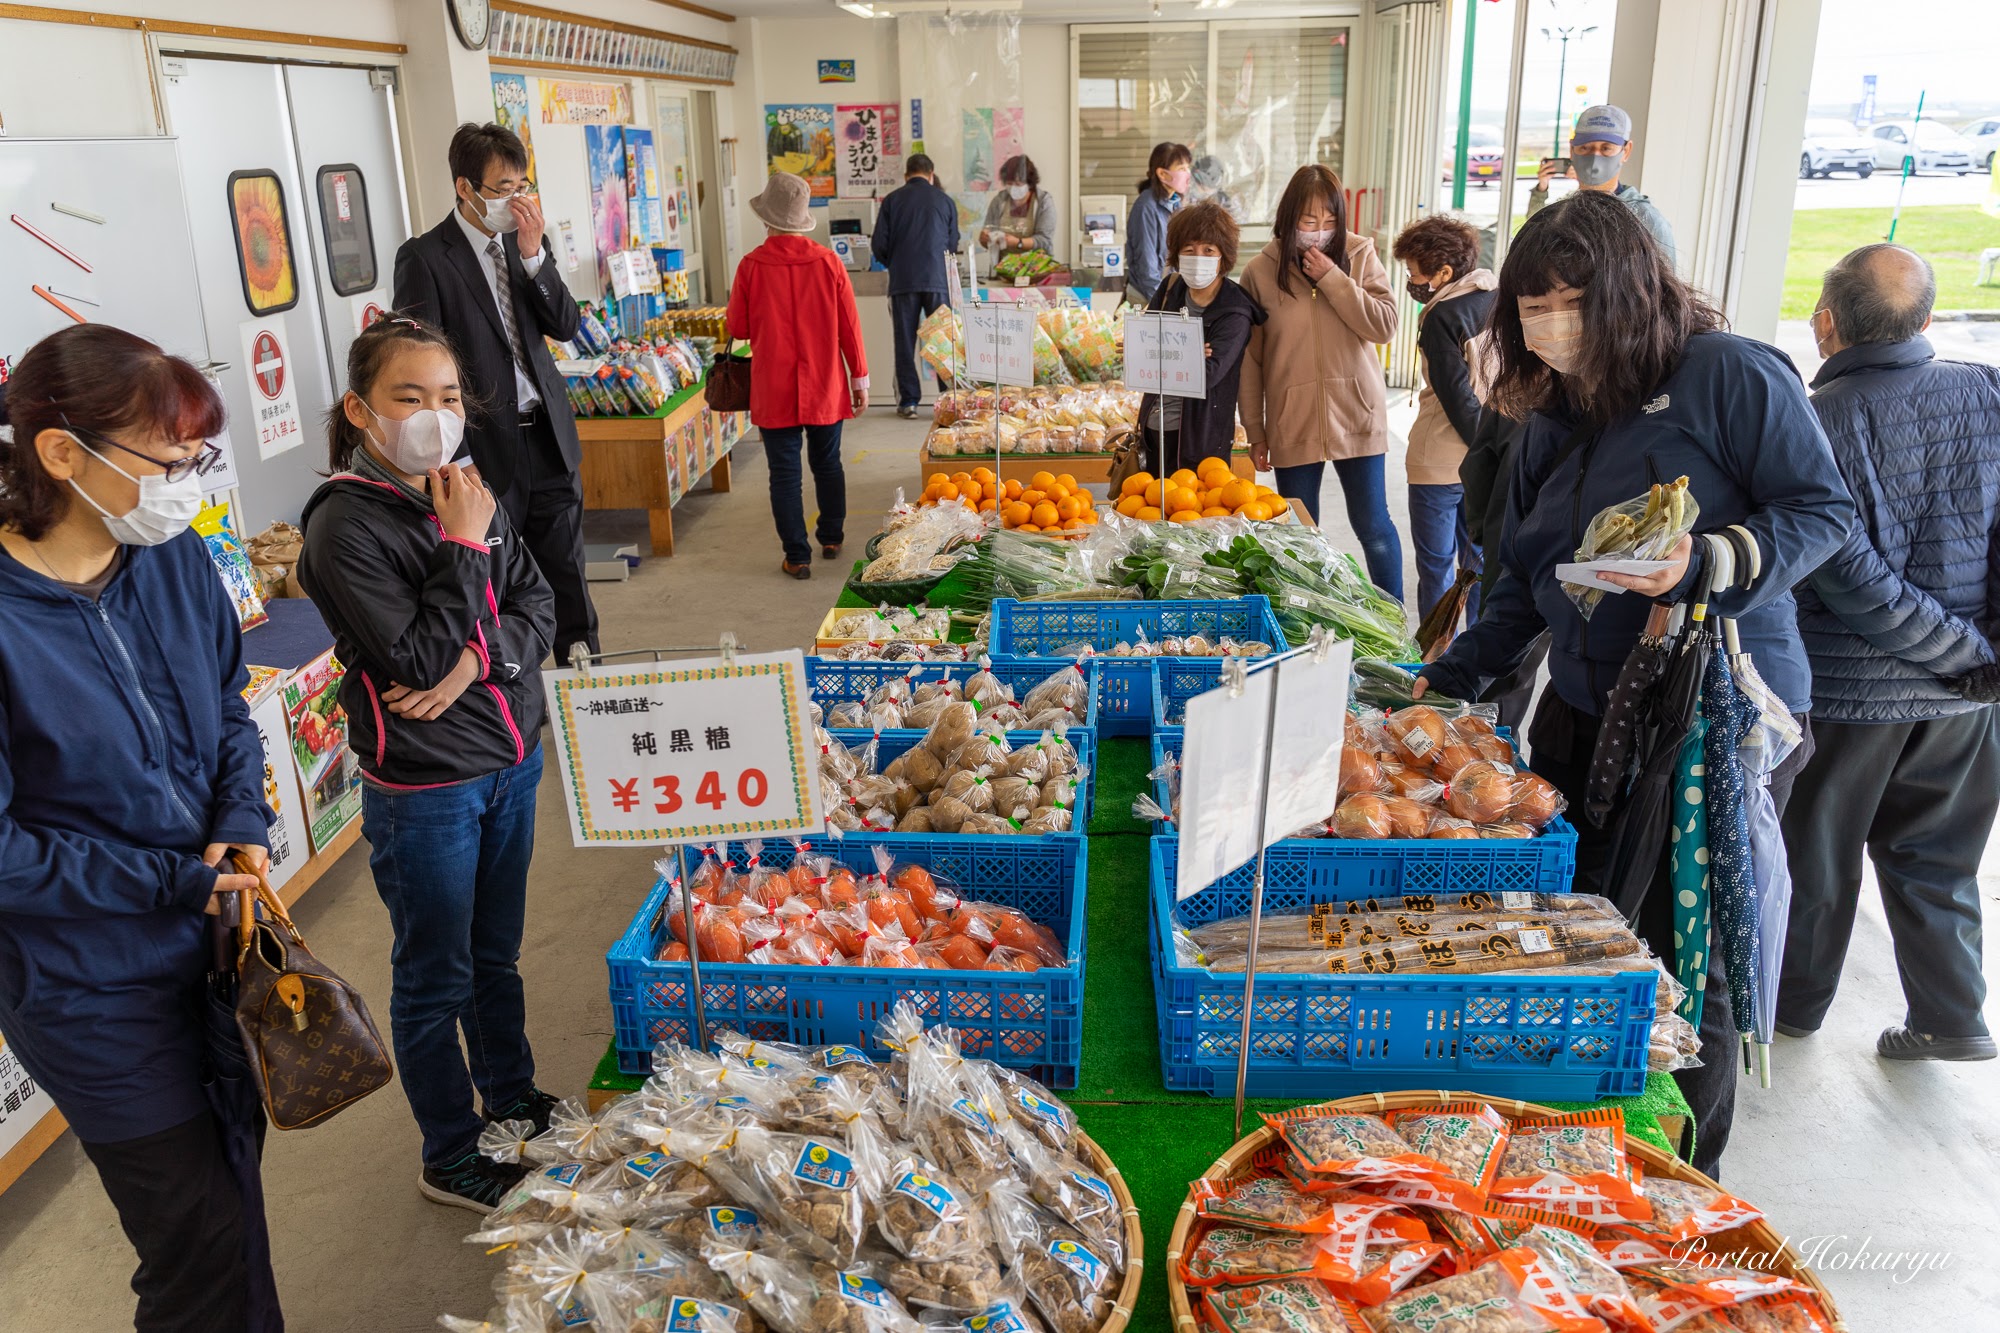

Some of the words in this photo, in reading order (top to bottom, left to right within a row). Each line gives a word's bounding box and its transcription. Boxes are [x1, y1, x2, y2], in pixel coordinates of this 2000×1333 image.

[855, 108, 878, 173] ひまわり
[848, 145, 863, 179] ライス
[261, 402, 291, 421] 関係者以外
[262, 418, 297, 444] 立入禁止
[608, 768, 769, 814] ¥340
[1361, 934, 1518, 974] ごぼう
[1443, 1115, 1472, 1140] 黒糖
[802, 1161, 834, 1182] 黒糖
[1394, 1292, 1440, 1322] 黒糖
